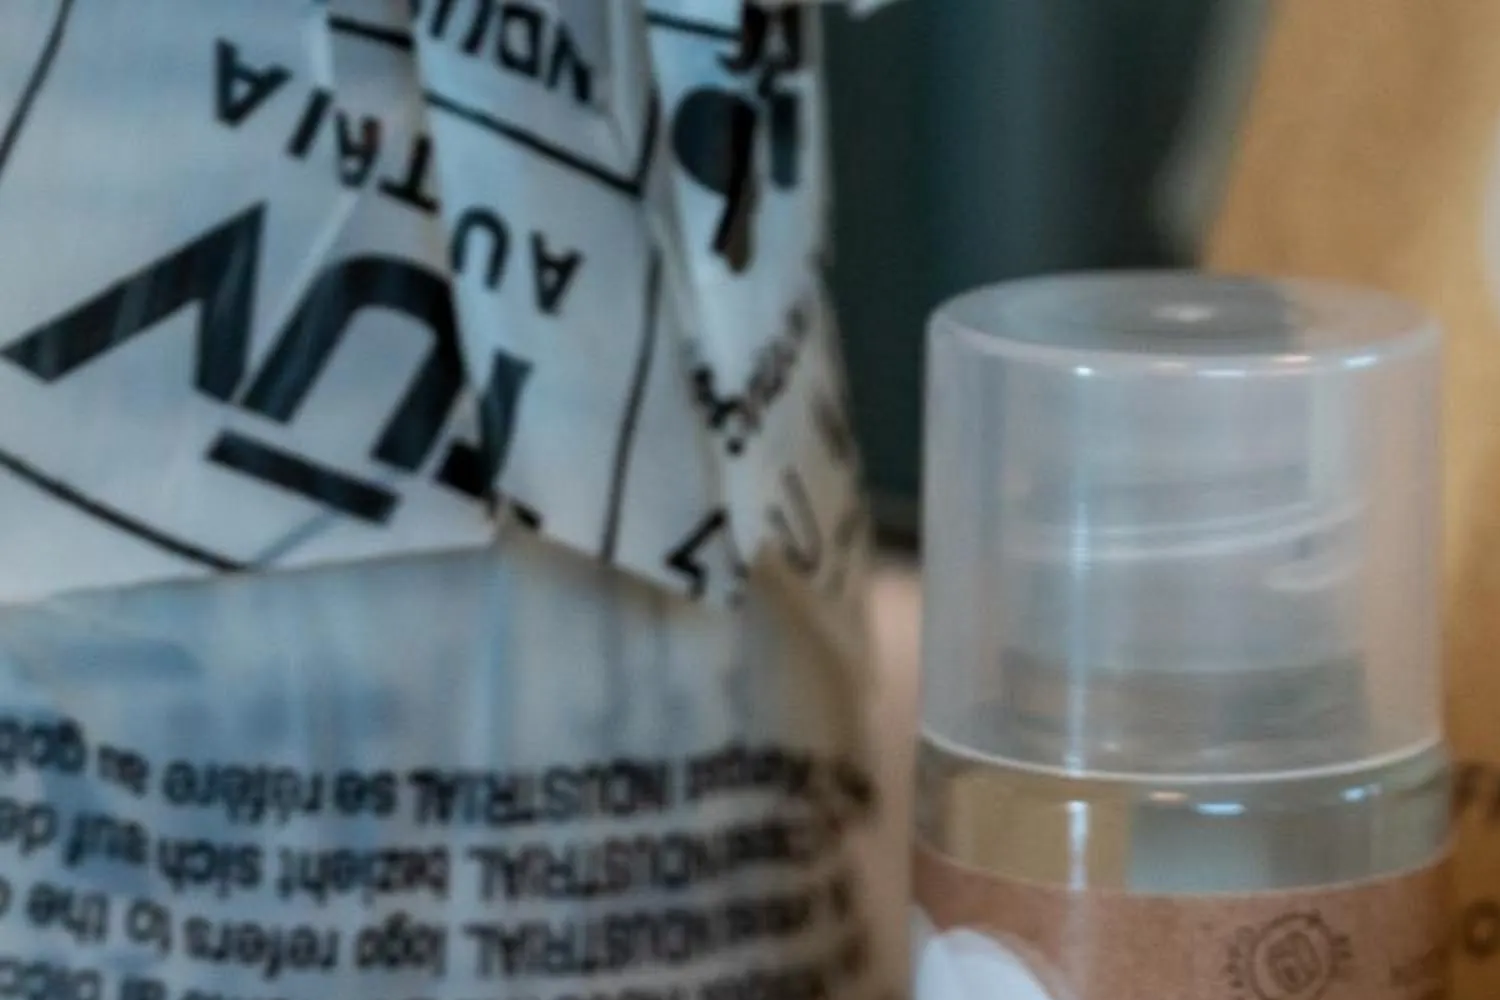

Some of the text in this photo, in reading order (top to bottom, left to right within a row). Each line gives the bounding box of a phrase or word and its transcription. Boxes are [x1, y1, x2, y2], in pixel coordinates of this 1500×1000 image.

[420, 0, 592, 106] NDU
[214, 37, 584, 316] AUTRIA
[24, 881, 109, 948] the
[124, 897, 172, 960] to
[183, 915, 338, 984] refers
